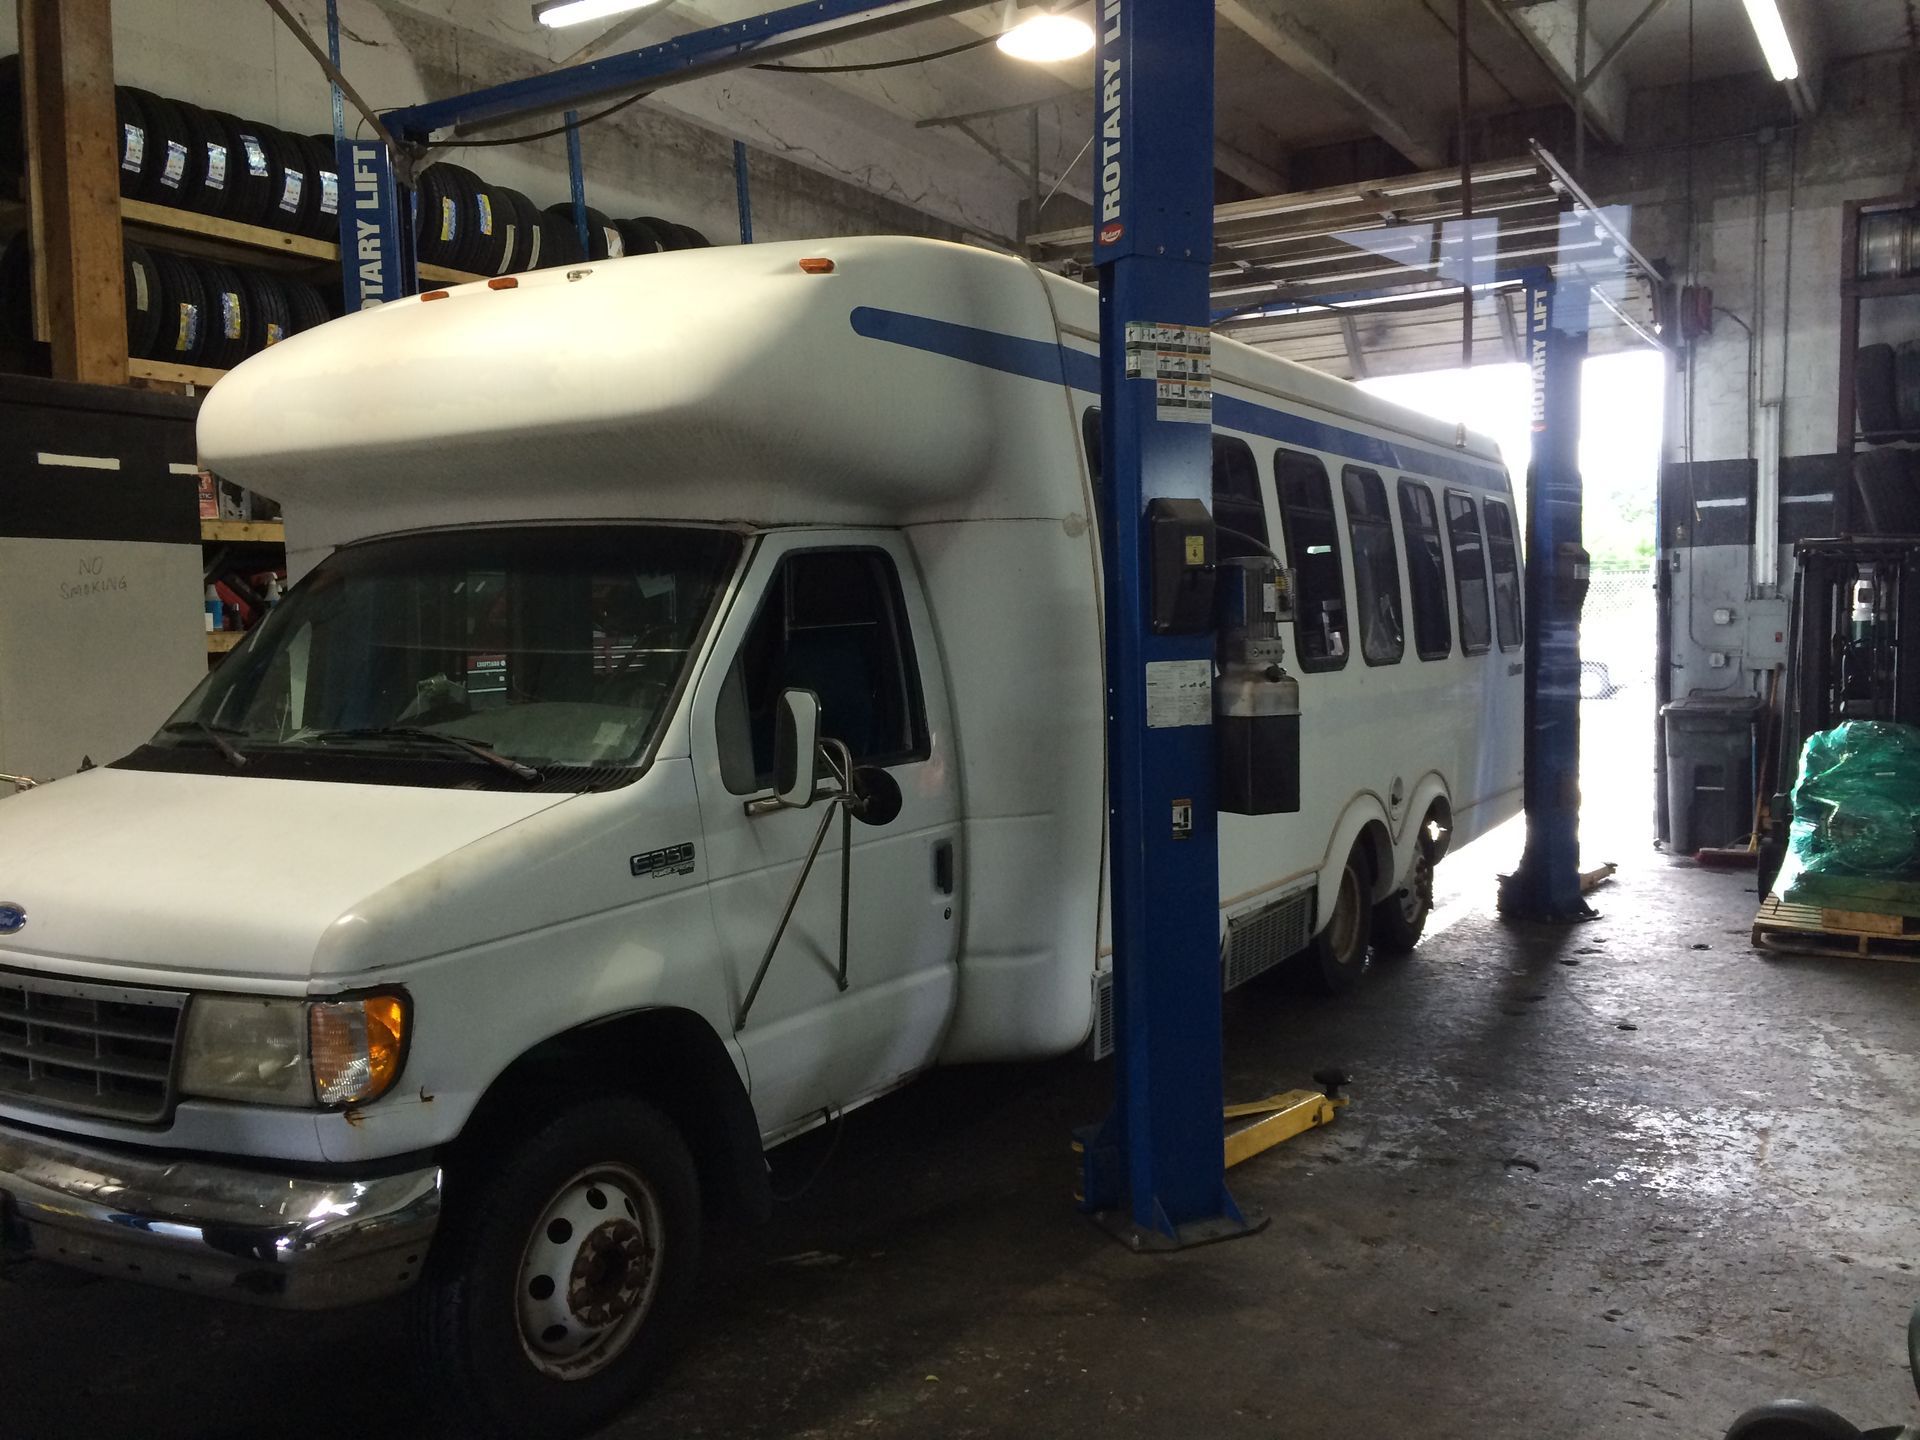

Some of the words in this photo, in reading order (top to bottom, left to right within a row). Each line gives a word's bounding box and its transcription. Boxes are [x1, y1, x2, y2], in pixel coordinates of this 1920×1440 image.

[1104, 0, 1121, 45] LI
[1103, 59, 1121, 222] ROTARY
[353, 145, 379, 209] LIFT
[1533, 289, 1547, 333] LIFT
[1532, 339, 1547, 421] ROTARY
[58, 576, 128, 600] SMOKING
[79, 556, 104, 575] NO
